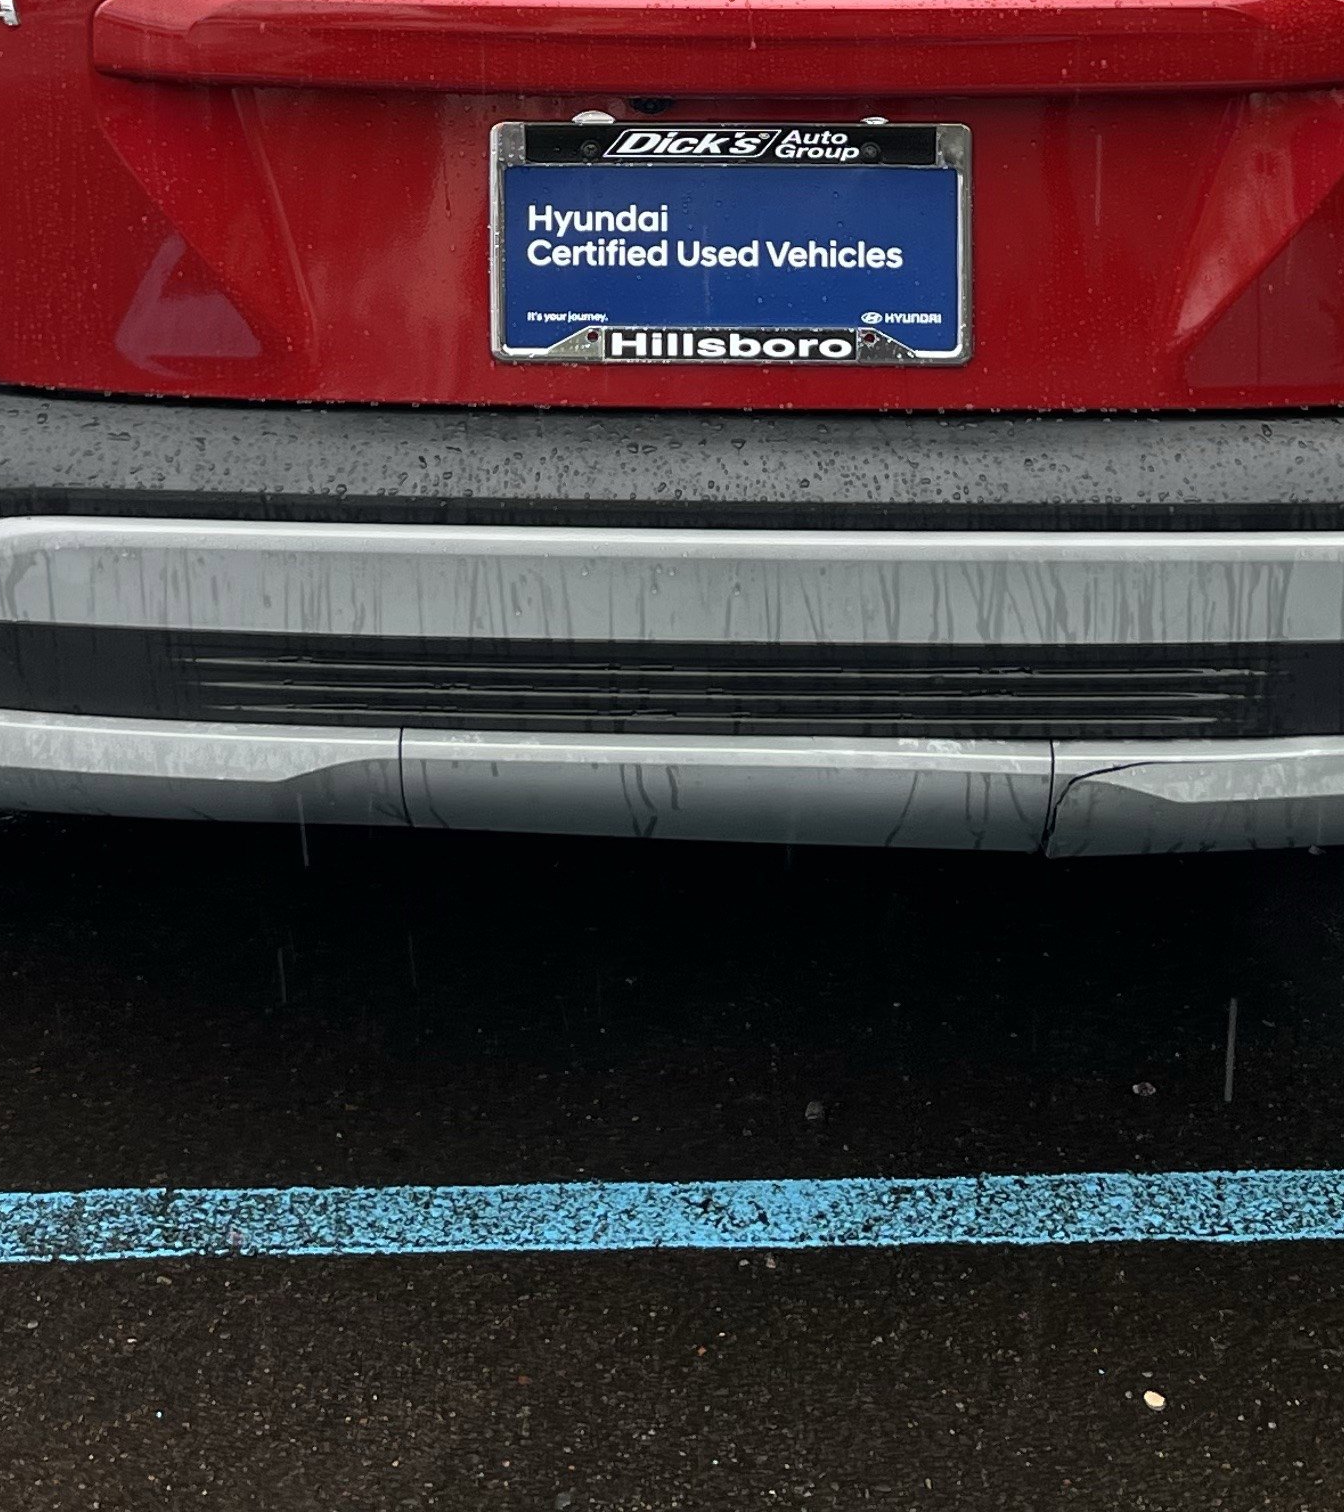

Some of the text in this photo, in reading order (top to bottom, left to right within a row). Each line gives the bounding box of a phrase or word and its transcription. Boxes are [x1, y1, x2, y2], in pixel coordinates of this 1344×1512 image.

[781, 129, 848, 145] Auto
[775, 144, 860, 162] Group
[527, 204, 669, 238] Hyundai
[526, 238, 904, 269] Certified Used Vehicles
[543, 312, 567, 323] your
[884, 312, 942, 324] HYUNDAI
[610, 332, 853, 358] Hillsboro
